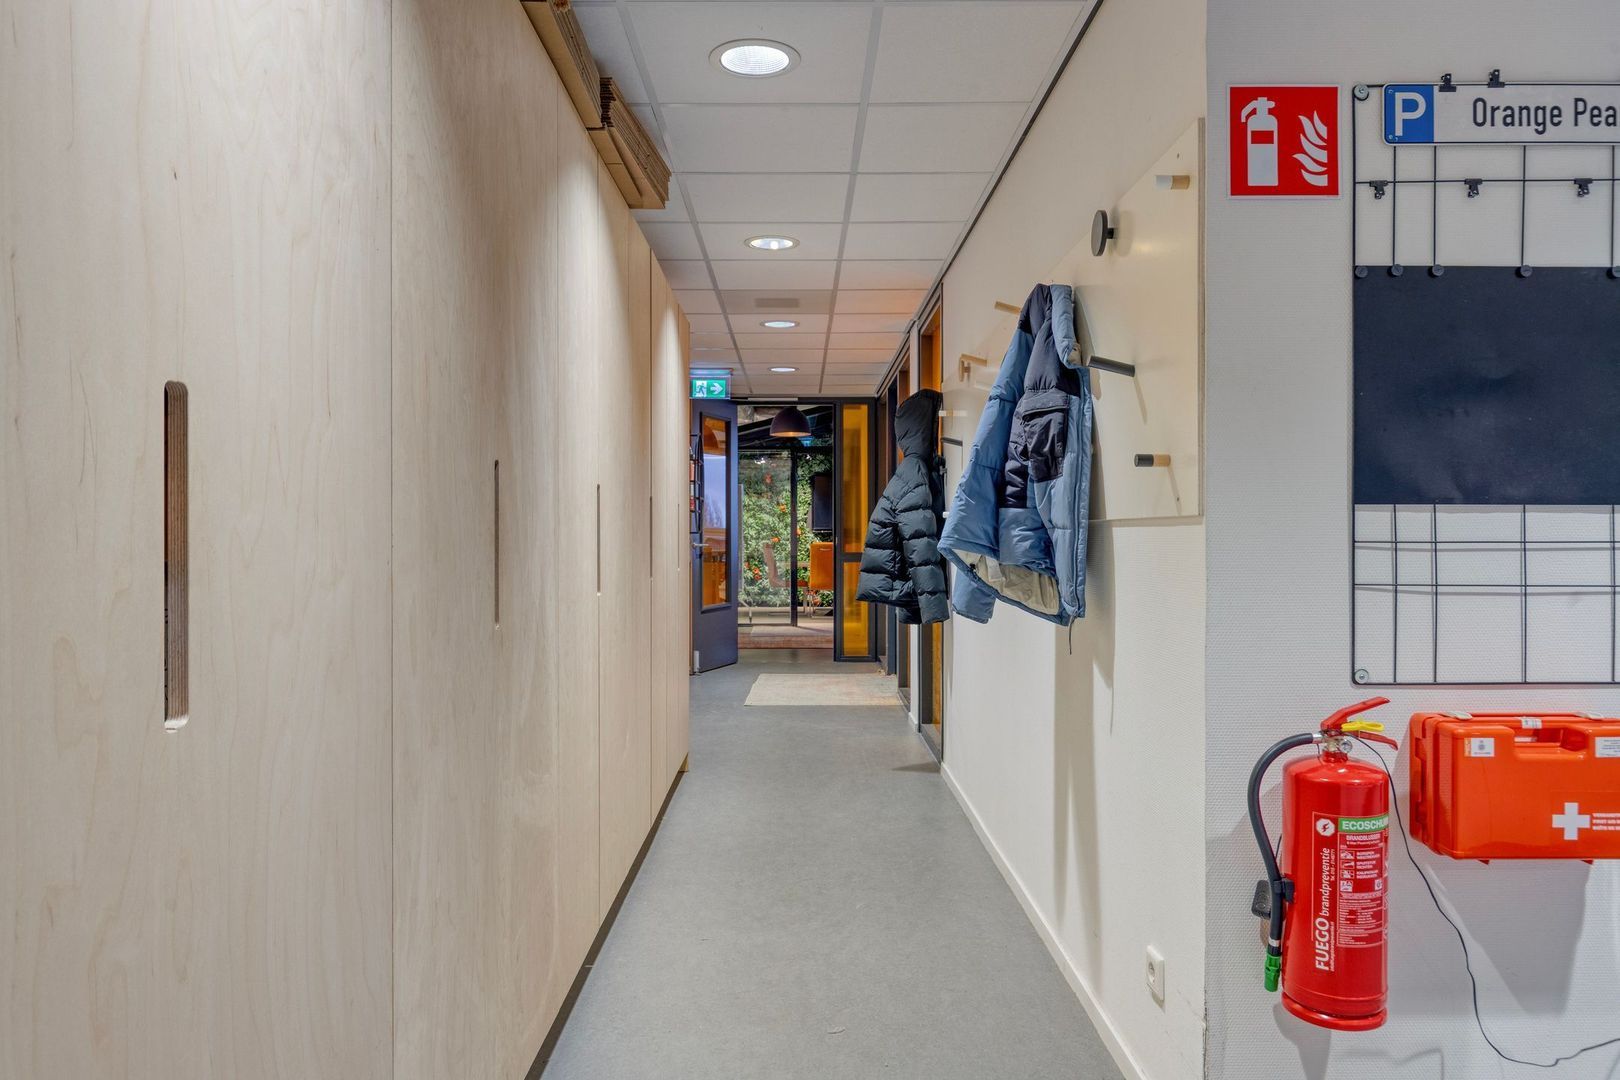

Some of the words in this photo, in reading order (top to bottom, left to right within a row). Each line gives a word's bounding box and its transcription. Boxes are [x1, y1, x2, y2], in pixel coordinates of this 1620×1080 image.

[1395, 92, 1427, 136] P
[1472, 97, 1563, 135] Orange
[1574, 97, 1617, 127] Pea
[1319, 848, 1332, 917] brandpreventie
[1315, 918, 1330, 970] FUEGO
